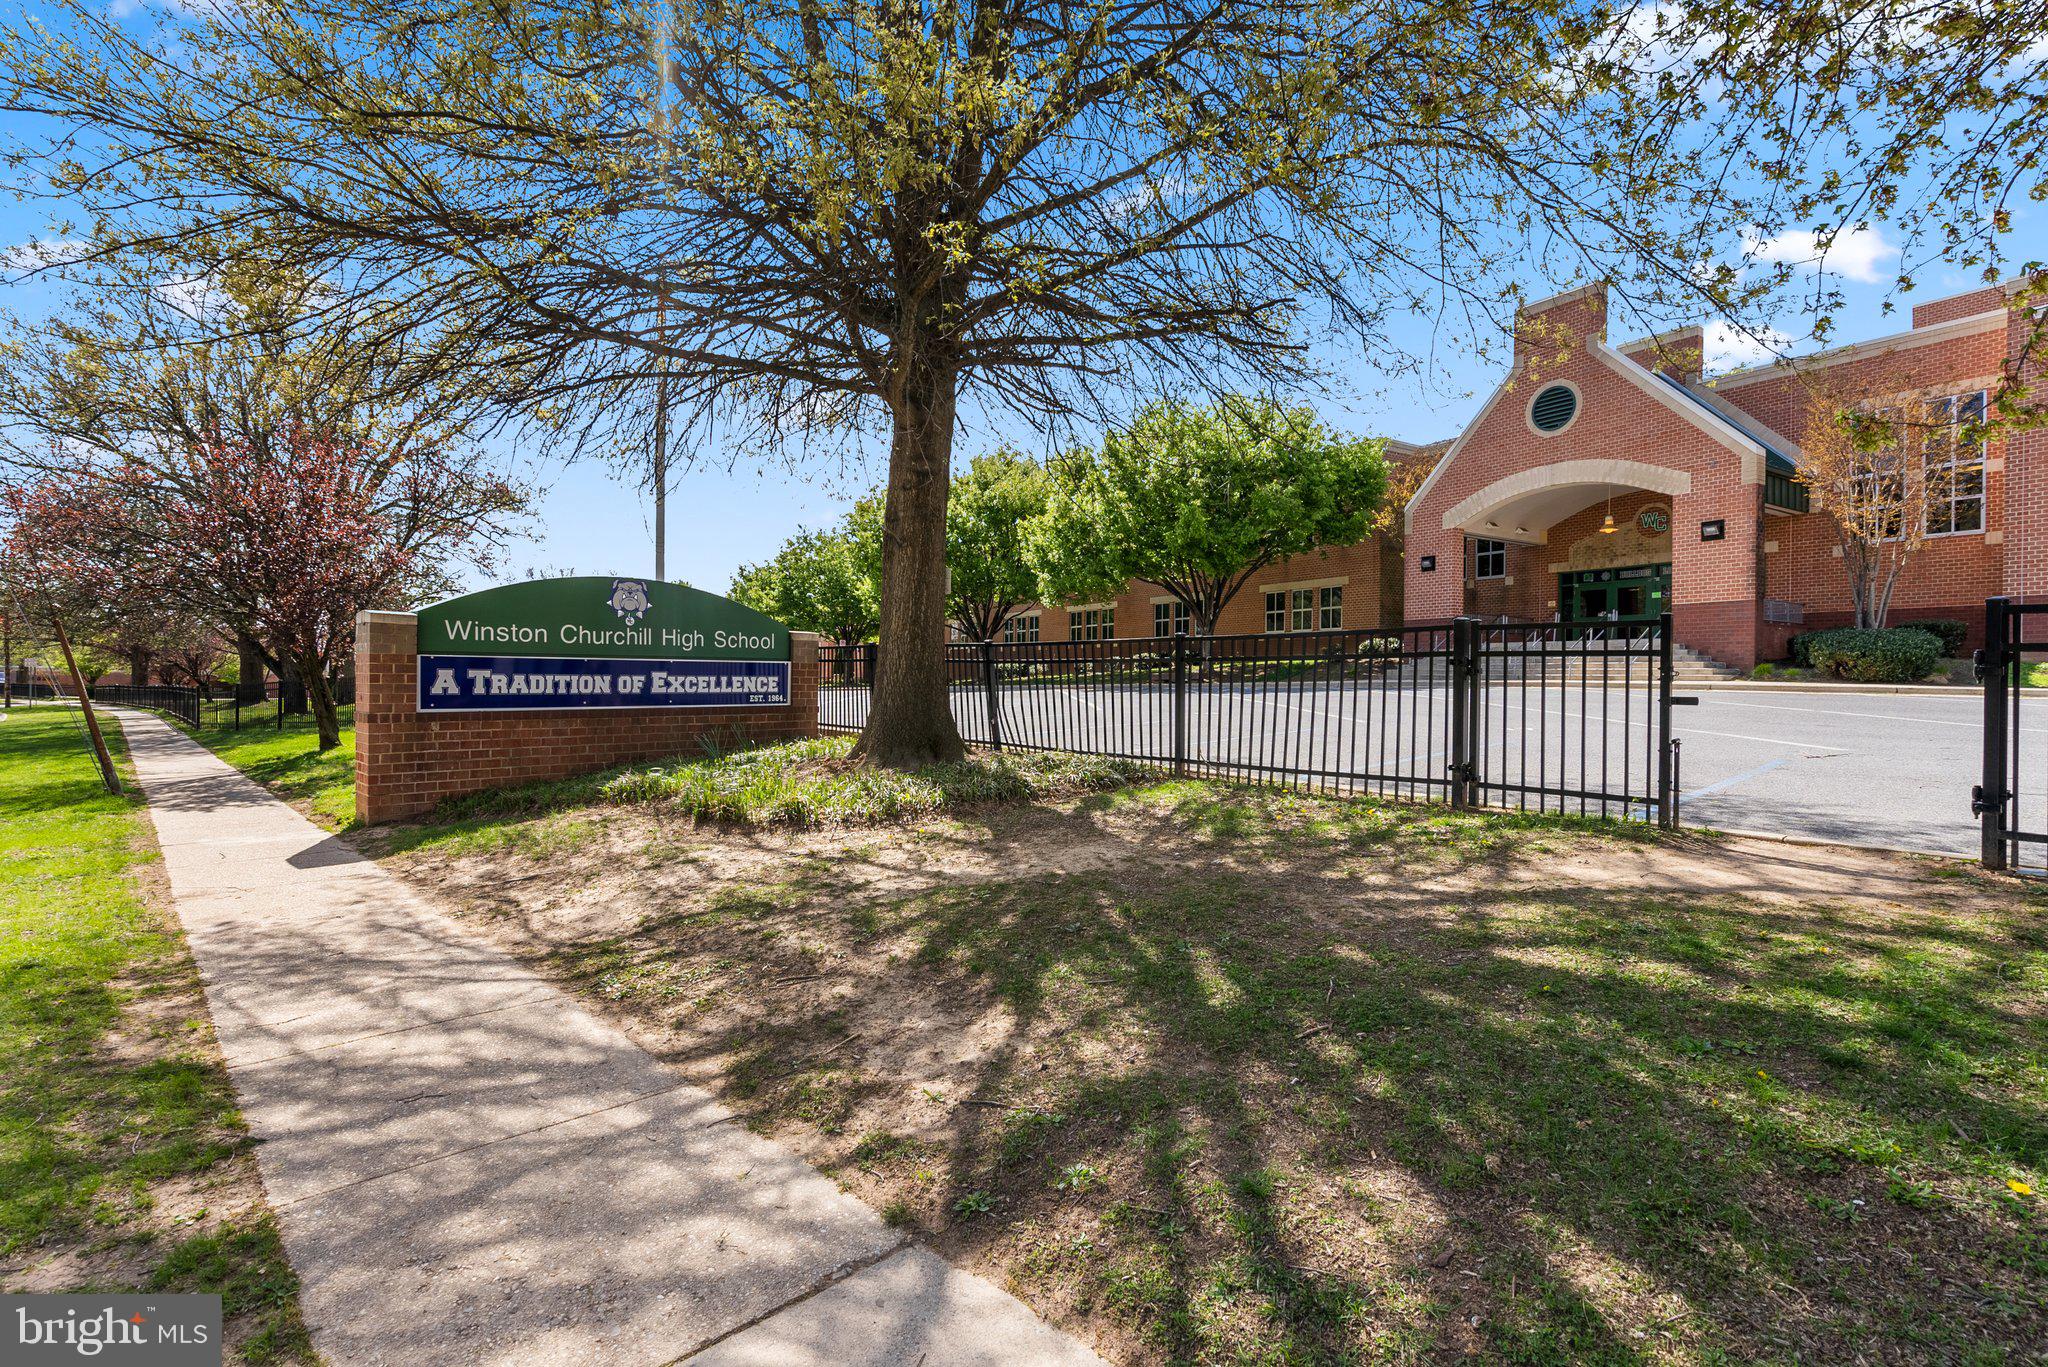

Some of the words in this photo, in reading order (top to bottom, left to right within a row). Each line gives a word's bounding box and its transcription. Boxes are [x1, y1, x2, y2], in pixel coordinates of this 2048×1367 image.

[1640, 512, 1667, 531] WC
[444, 619, 549, 643] Winston
[560, 624, 652, 646] Churchill
[662, 628, 705, 651] High
[714, 630, 775, 650] School
[430, 668, 461, 695] A
[467, 669, 611, 695] TRADITION
[618, 675, 646, 694] OF
[651, 671, 779, 694] EXCELLENCE
[749, 694, 766, 702] EST.
